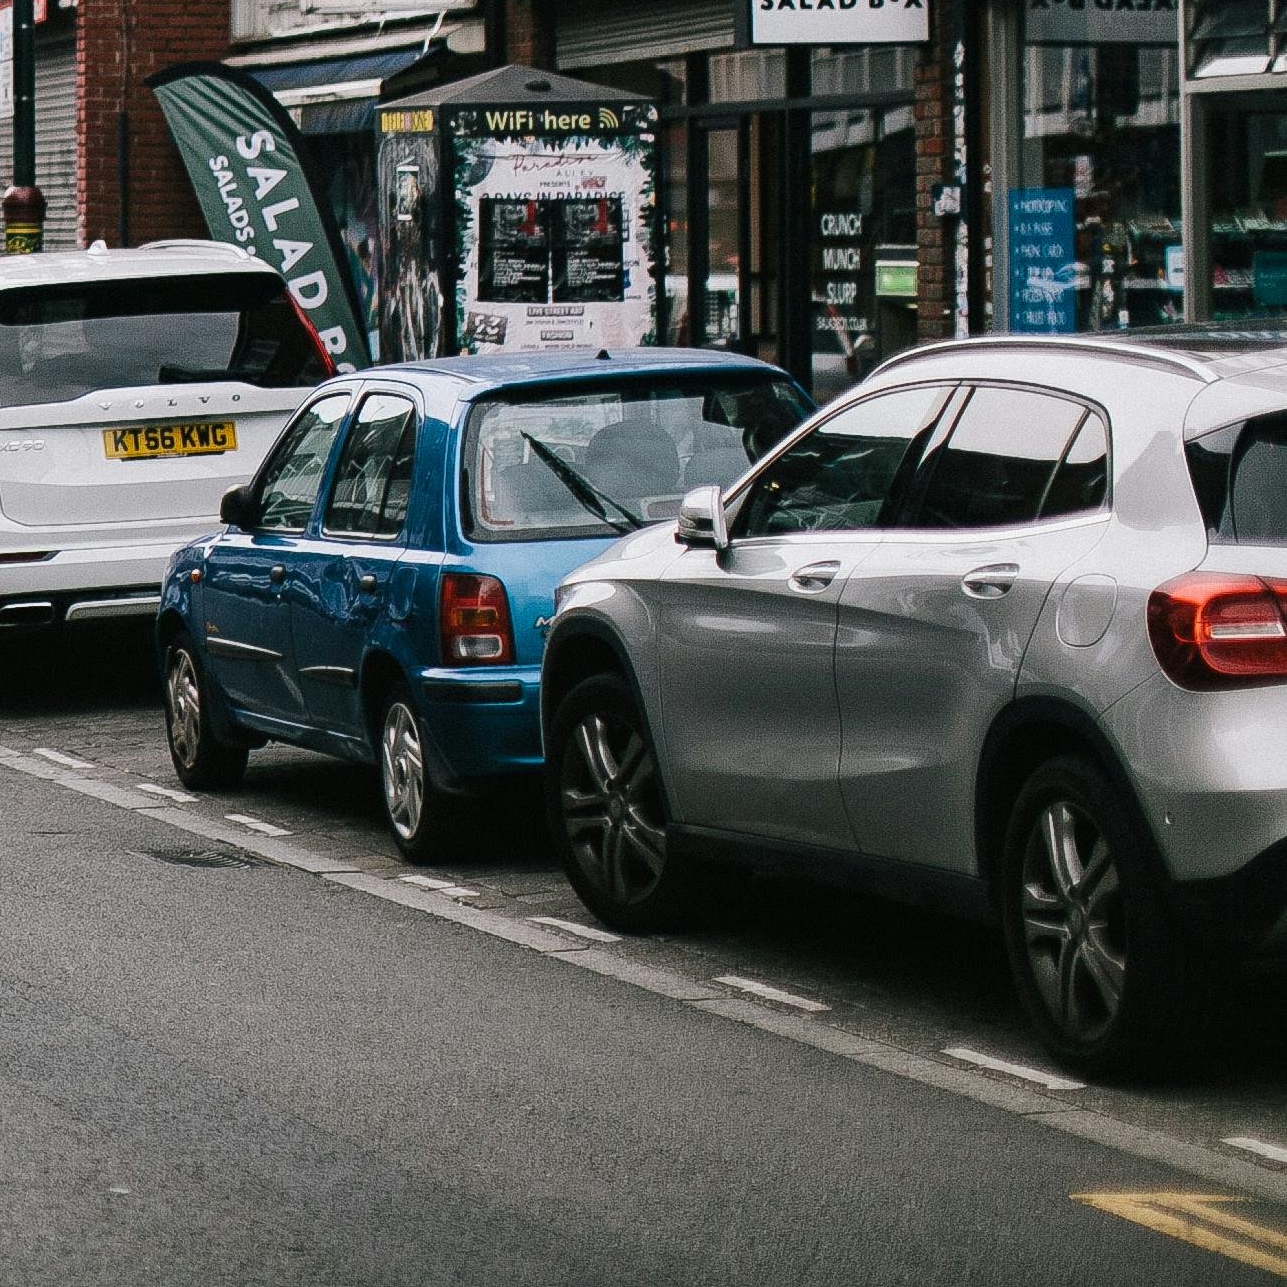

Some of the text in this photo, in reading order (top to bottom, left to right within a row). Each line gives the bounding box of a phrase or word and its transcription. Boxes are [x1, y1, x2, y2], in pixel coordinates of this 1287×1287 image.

[486, 110, 591, 129] WiFi here
[209, 155, 255, 242] SALADS
[236, 129, 327, 310] SALAD
[821, 214, 862, 235] CRUNCH
[823, 248, 860, 270] MUNCH
[827, 282, 857, 304] SLURP
[98, 394, 241, 410] VOLVO
[112, 424, 228, 453] KT66 KWG
